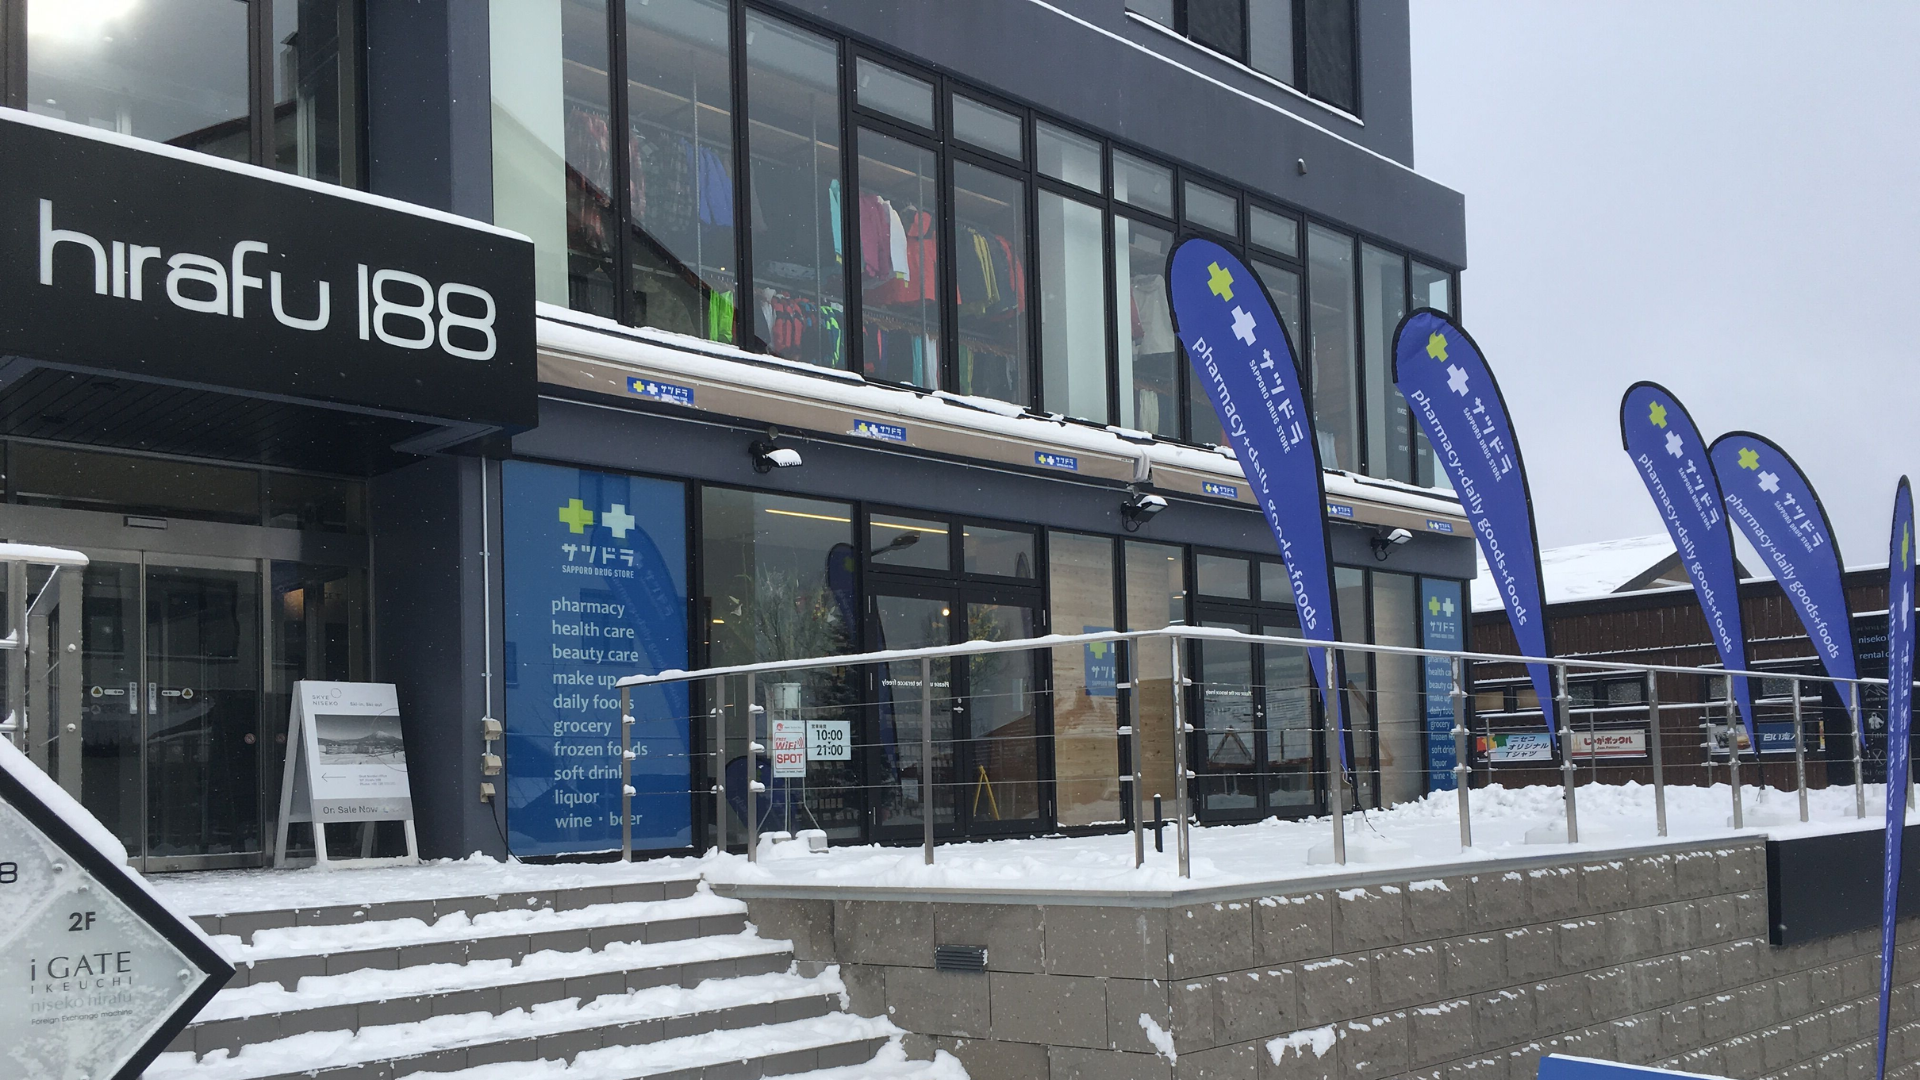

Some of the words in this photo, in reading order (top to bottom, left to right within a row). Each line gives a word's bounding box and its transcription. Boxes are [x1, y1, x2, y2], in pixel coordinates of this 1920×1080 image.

[40, 198, 329, 331] hirafu
[358, 263, 497, 361] 188
[1259, 348, 1303, 445] サツドラ
[1249, 359, 1270, 404] SAPPORO
[1266, 401, 1279, 429] DRUG
[1276, 425, 1291, 454] STORE
[1463, 407, 1481, 440] SAPPORO
[1479, 439, 1492, 460] DRUG
[1489, 458, 1502, 482] STORE
[561, 543, 634, 567] サツドラ
[562, 564, 593, 575] SAPPORO
[594, 567, 613, 577] DRUG
[614, 570, 635, 579] STORE
[552, 596, 625, 618] pharmacy
[552, 620, 600, 637] health
[603, 626, 635, 639] care
[1858, 635, 1887, 644] niseko
[552, 643, 604, 664] beauty
[608, 649, 639, 662] care
[1859, 650, 1884, 659] rental
[553, 670, 594, 685] make
[598, 675, 617, 690] up
[553, 693, 589, 713] daily
[593, 694, 635, 710] foos
[553, 720, 612, 737] grocery
[1430, 721, 1450, 730] grocery
[816, 729, 843, 741] 10:00
[1584, 736, 1633, 746] じがポックル
[554, 741, 603, 756] frozen
[607, 741, 648, 756] fods
[816, 744, 843, 756] 21:00
[1508, 742, 1549, 750] オリジナル
[776, 753, 803, 764] SPOT
[554, 765, 584, 781] soft
[555, 789, 600, 808] liquor
[337, 805, 357, 814] Sale
[359, 805, 378, 814] Now
[555, 813, 593, 829] wine
[68, 911, 96, 932] 2F
[47, 951, 132, 979] GATE
[31, 995, 84, 1013] niseko
[31, 1018, 60, 1026] Foreign
